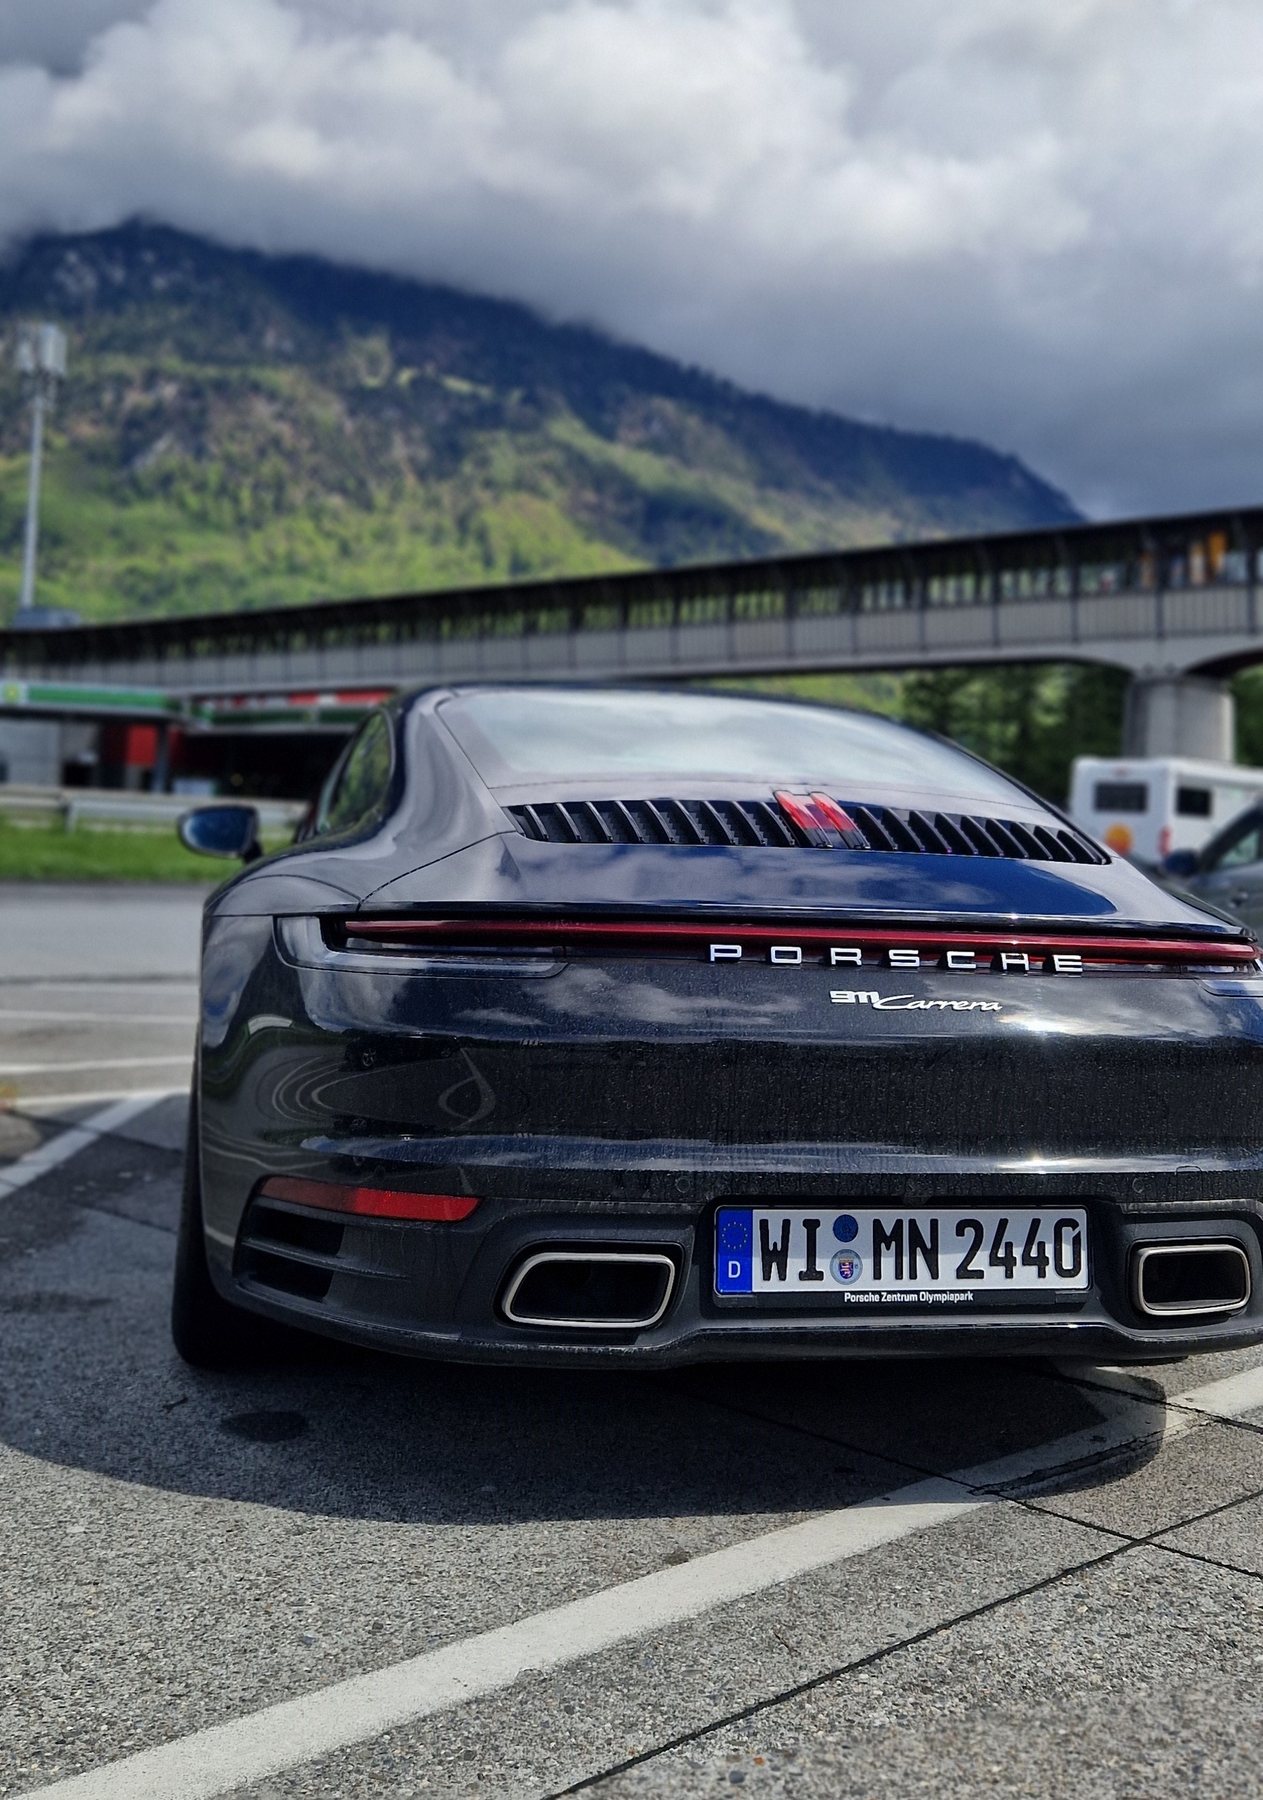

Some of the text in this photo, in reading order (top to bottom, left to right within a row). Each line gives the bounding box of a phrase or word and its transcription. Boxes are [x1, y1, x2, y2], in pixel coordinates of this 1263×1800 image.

[709, 943, 1083, 973] PORSCHE
[829, 989, 1003, 1011] 911 Carrera
[758, 1216, 1083, 1282] WI MN 2440
[727, 1260, 741, 1279] D
[843, 1290, 974, 1304] Porsche Zentrum Olympiapark
